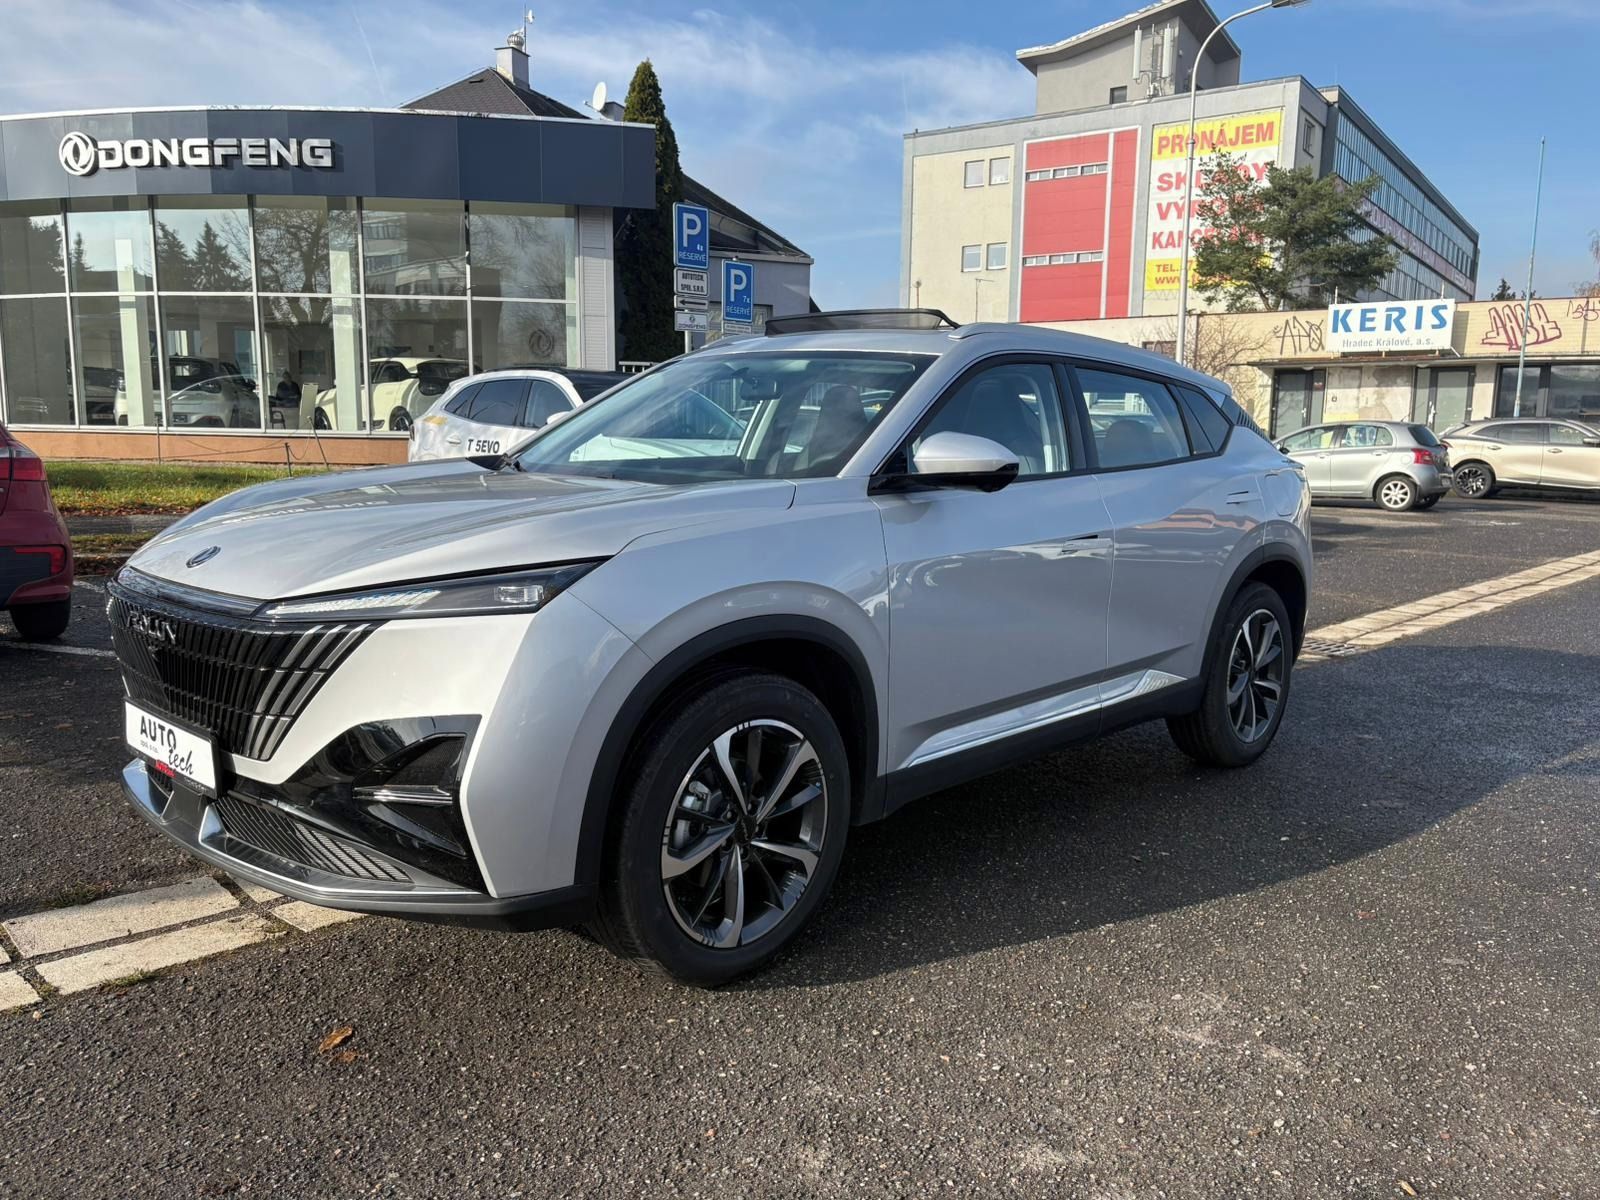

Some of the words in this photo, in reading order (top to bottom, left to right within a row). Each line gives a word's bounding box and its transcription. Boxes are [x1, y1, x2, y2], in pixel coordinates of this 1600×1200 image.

[97, 137, 333, 168] DONGFENG
[1157, 121, 1274, 155] PRONÁJEM
[682, 212, 702, 248] P
[730, 268, 747, 302] P
[1332, 304, 1448, 334] KERIS
[1342, 338, 1373, 348] Hradec
[140, 715, 177, 751] AUTO
